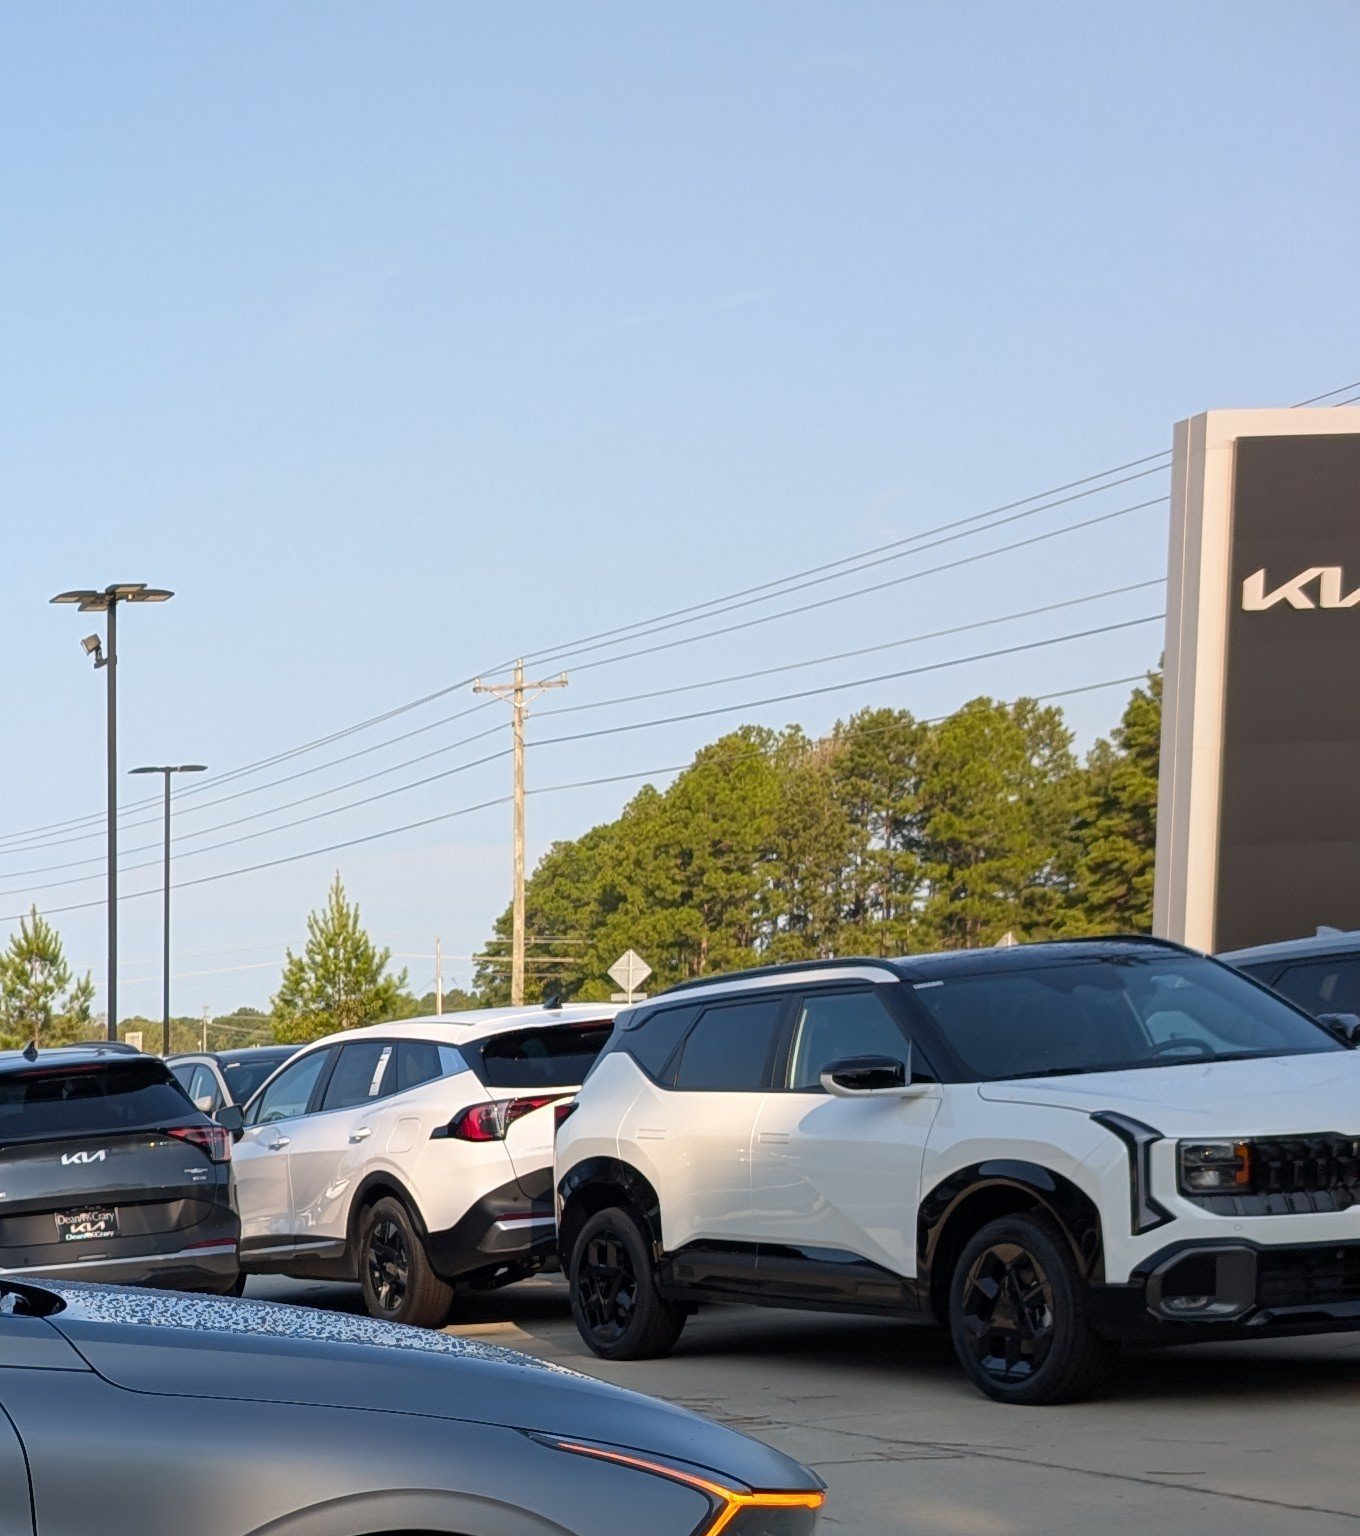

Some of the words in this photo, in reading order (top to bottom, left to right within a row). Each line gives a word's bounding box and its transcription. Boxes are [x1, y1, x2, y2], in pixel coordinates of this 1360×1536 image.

[1243, 566, 1360, 611] KI
[61, 1150, 105, 1165] KIA
[70, 1221, 105, 1233] KIA
